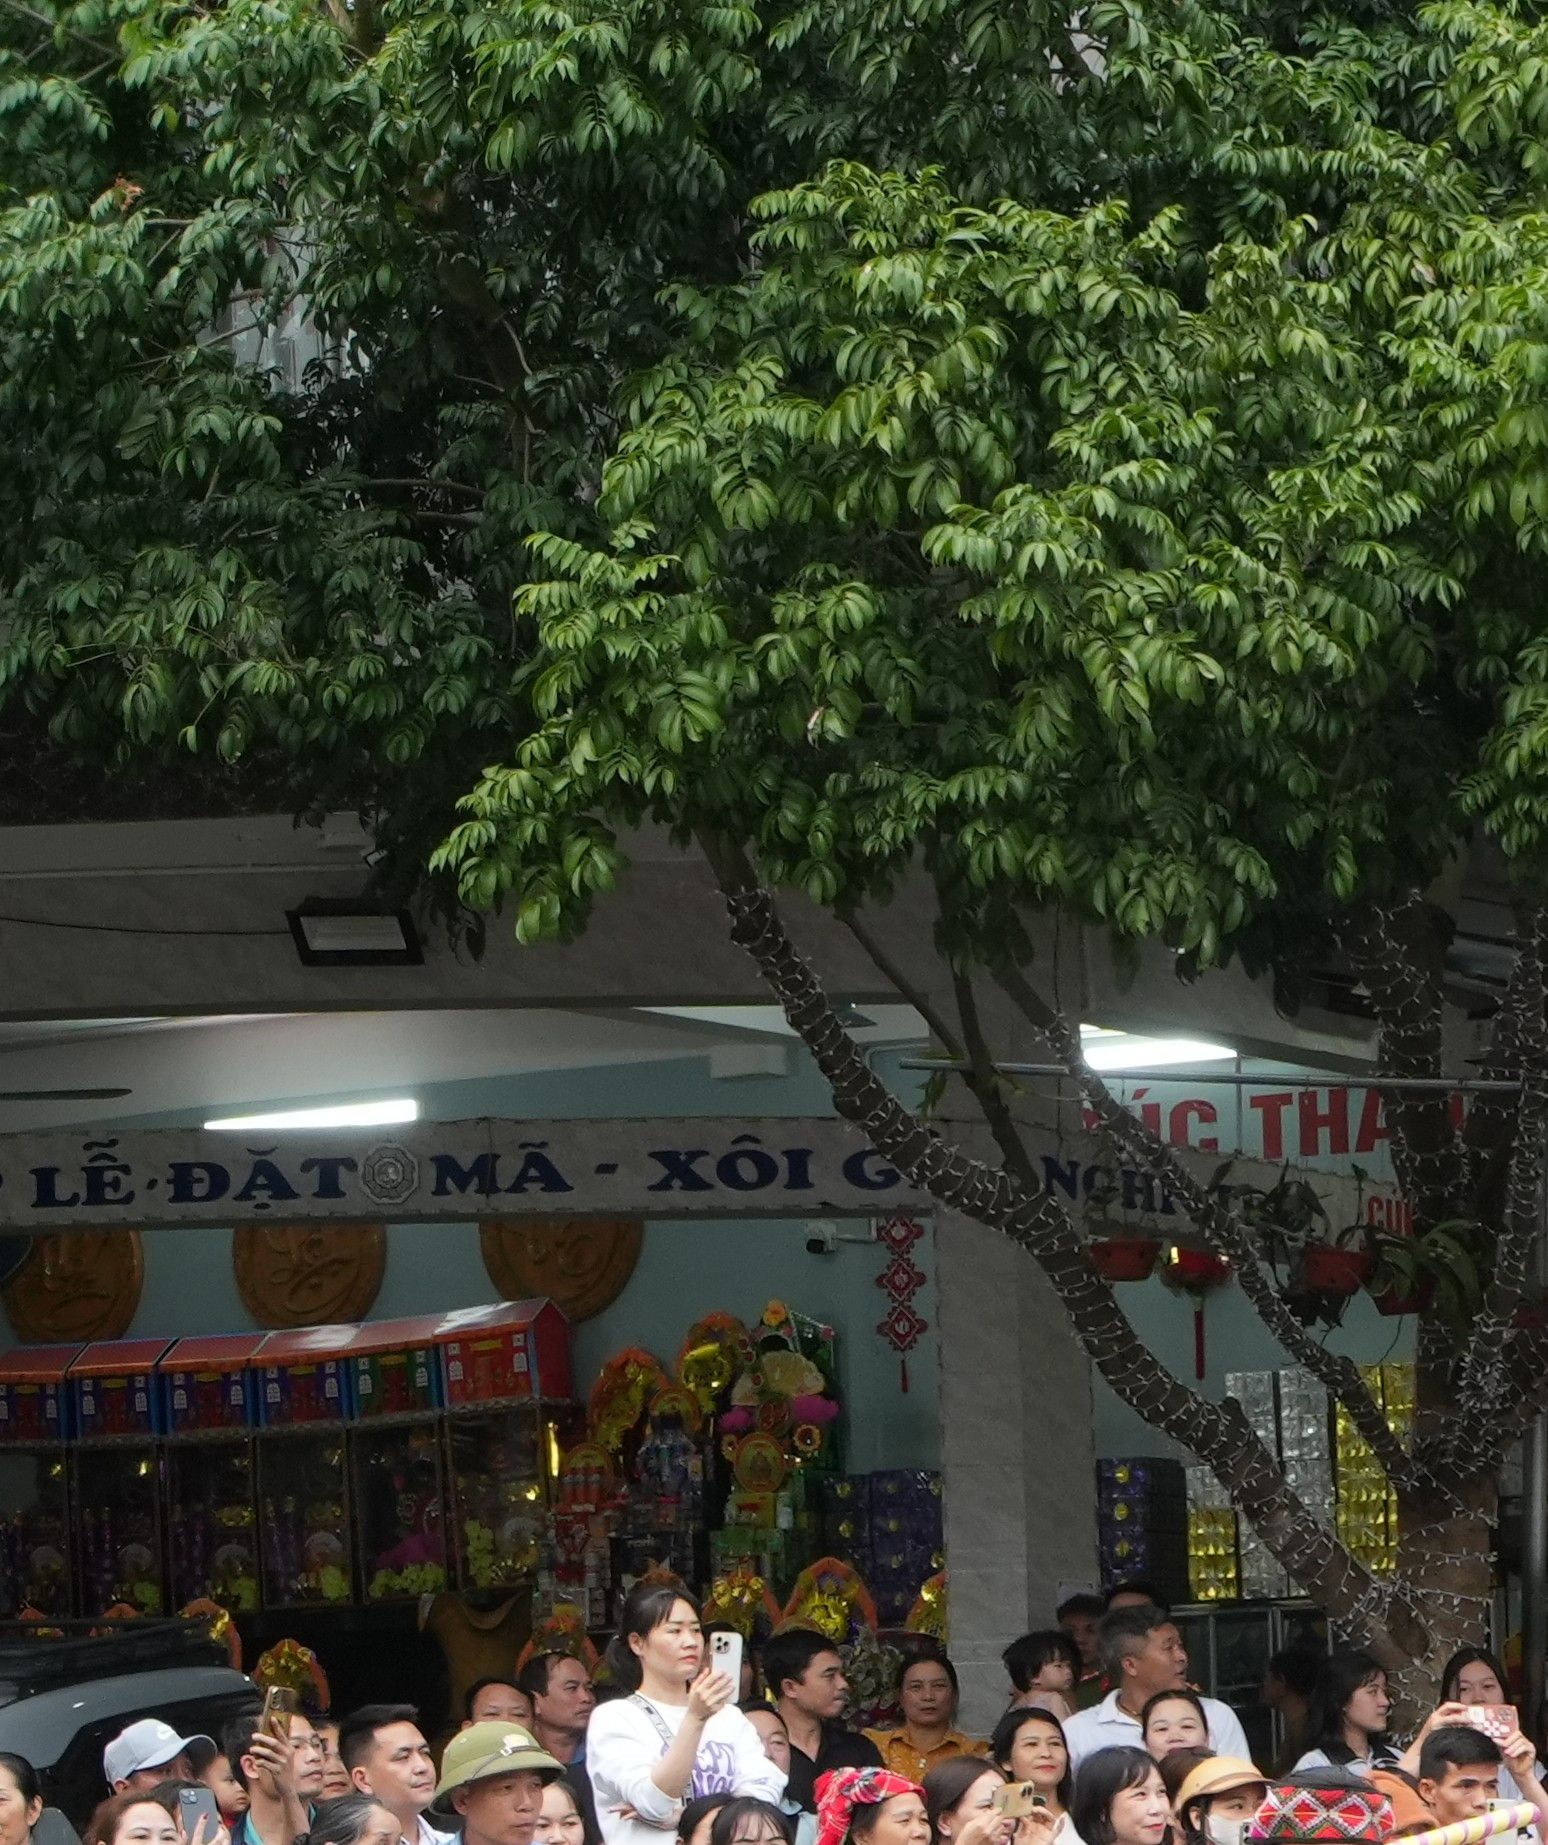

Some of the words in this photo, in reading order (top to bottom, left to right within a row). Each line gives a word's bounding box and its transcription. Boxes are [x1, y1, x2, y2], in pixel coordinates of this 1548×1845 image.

[29, 1139, 136, 1208] LỄ
[167, 1145, 358, 1210] ĐẶT
[430, 1140, 575, 1196] MÃ
[647, 1134, 815, 1192] XÔI
